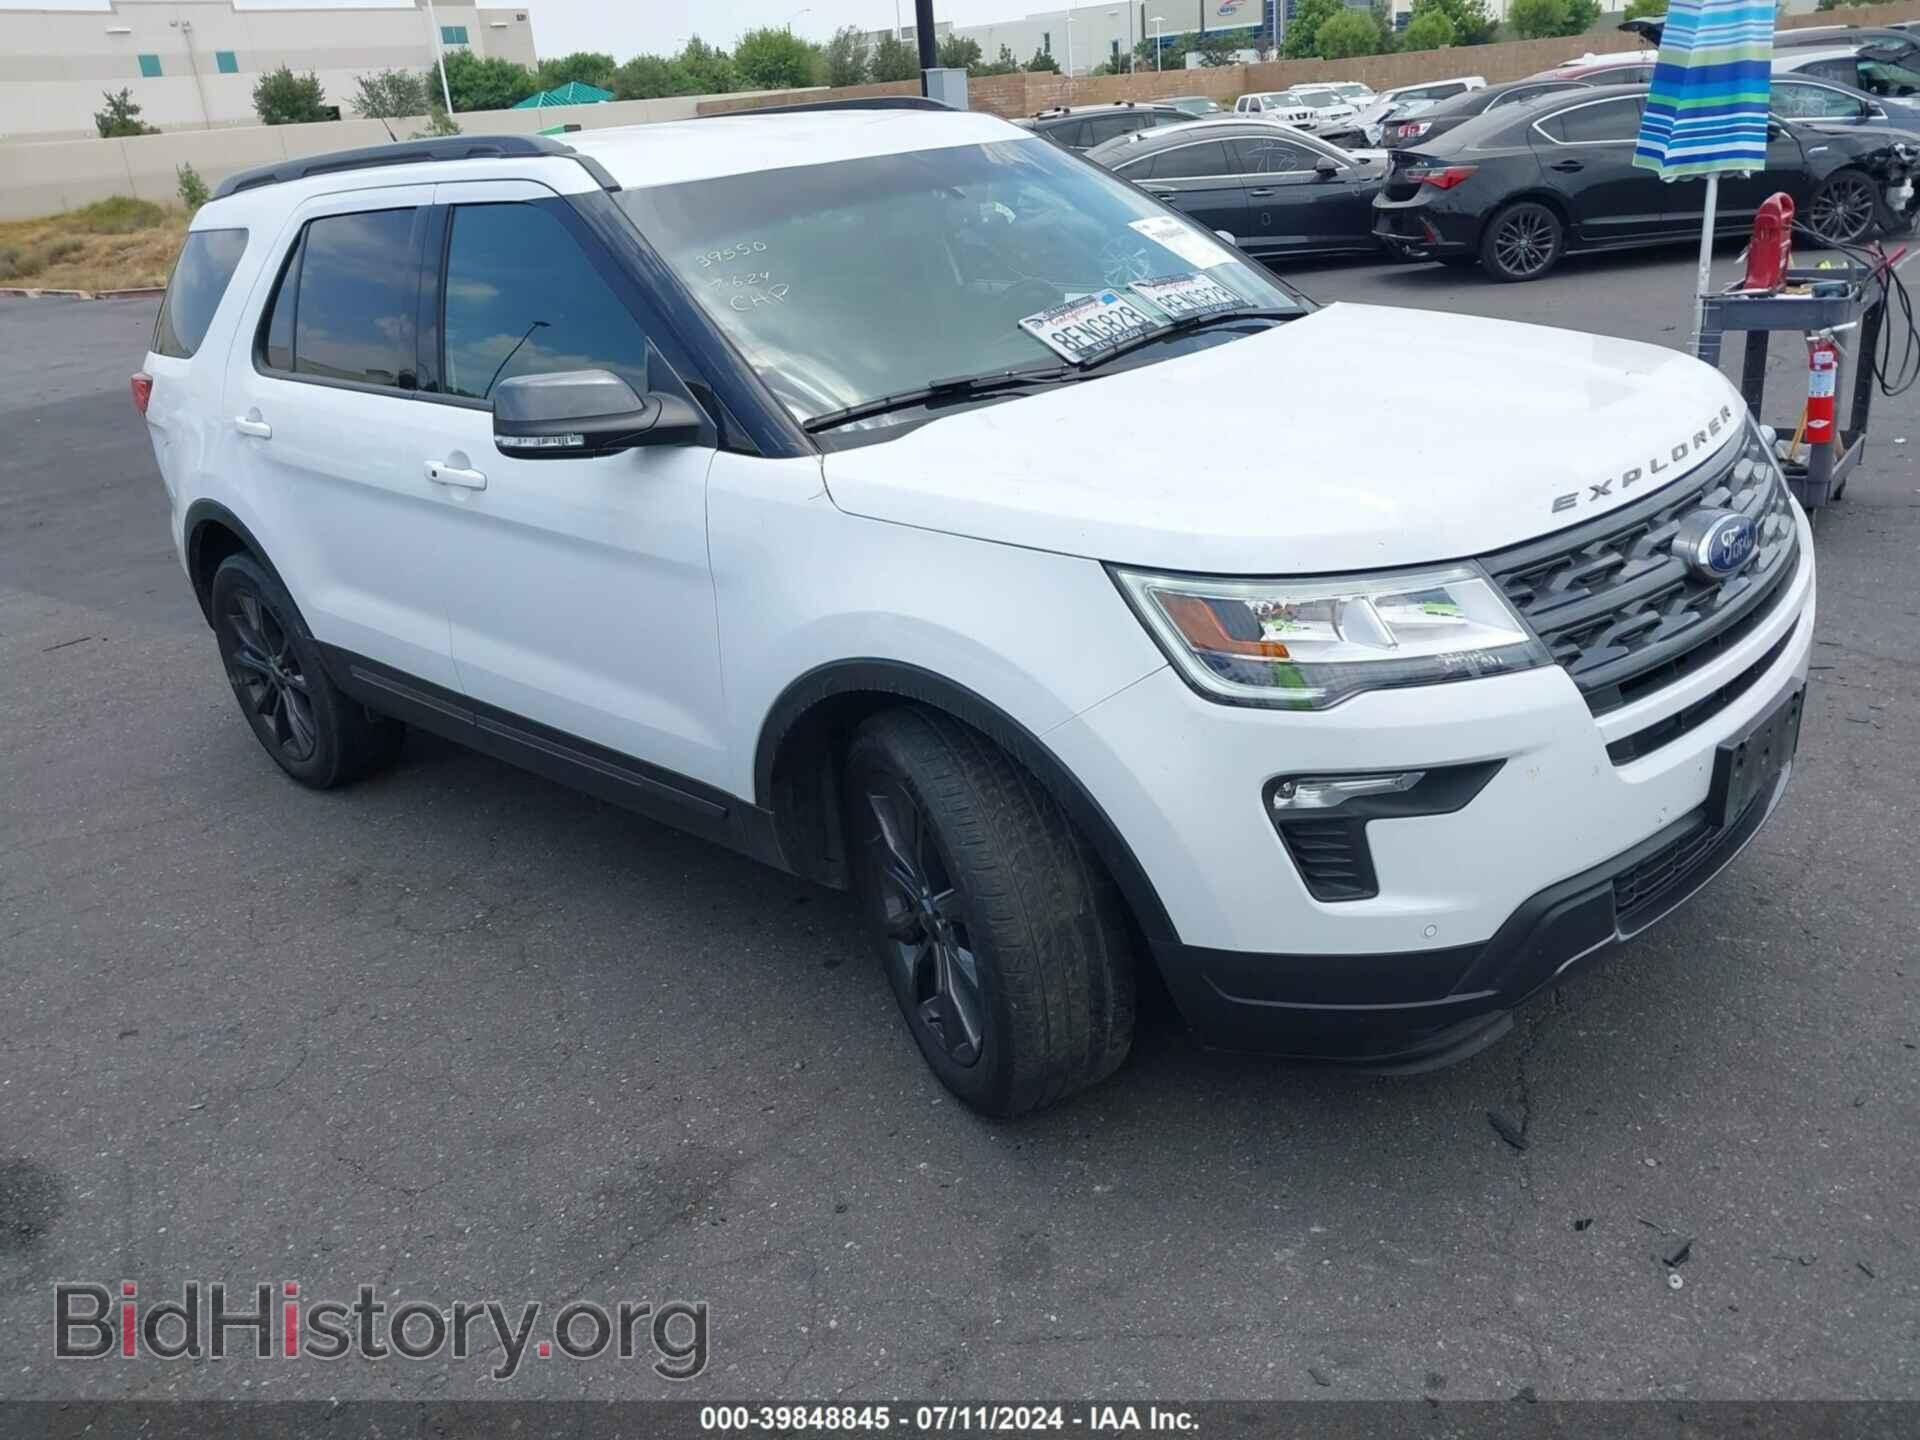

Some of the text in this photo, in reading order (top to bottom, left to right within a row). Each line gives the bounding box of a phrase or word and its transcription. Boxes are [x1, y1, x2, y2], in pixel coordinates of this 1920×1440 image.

[1050, 305, 1147, 352] 8FNG828
[1551, 404, 1732, 514] EXPLORER
[1720, 524, 1751, 566] Ford
